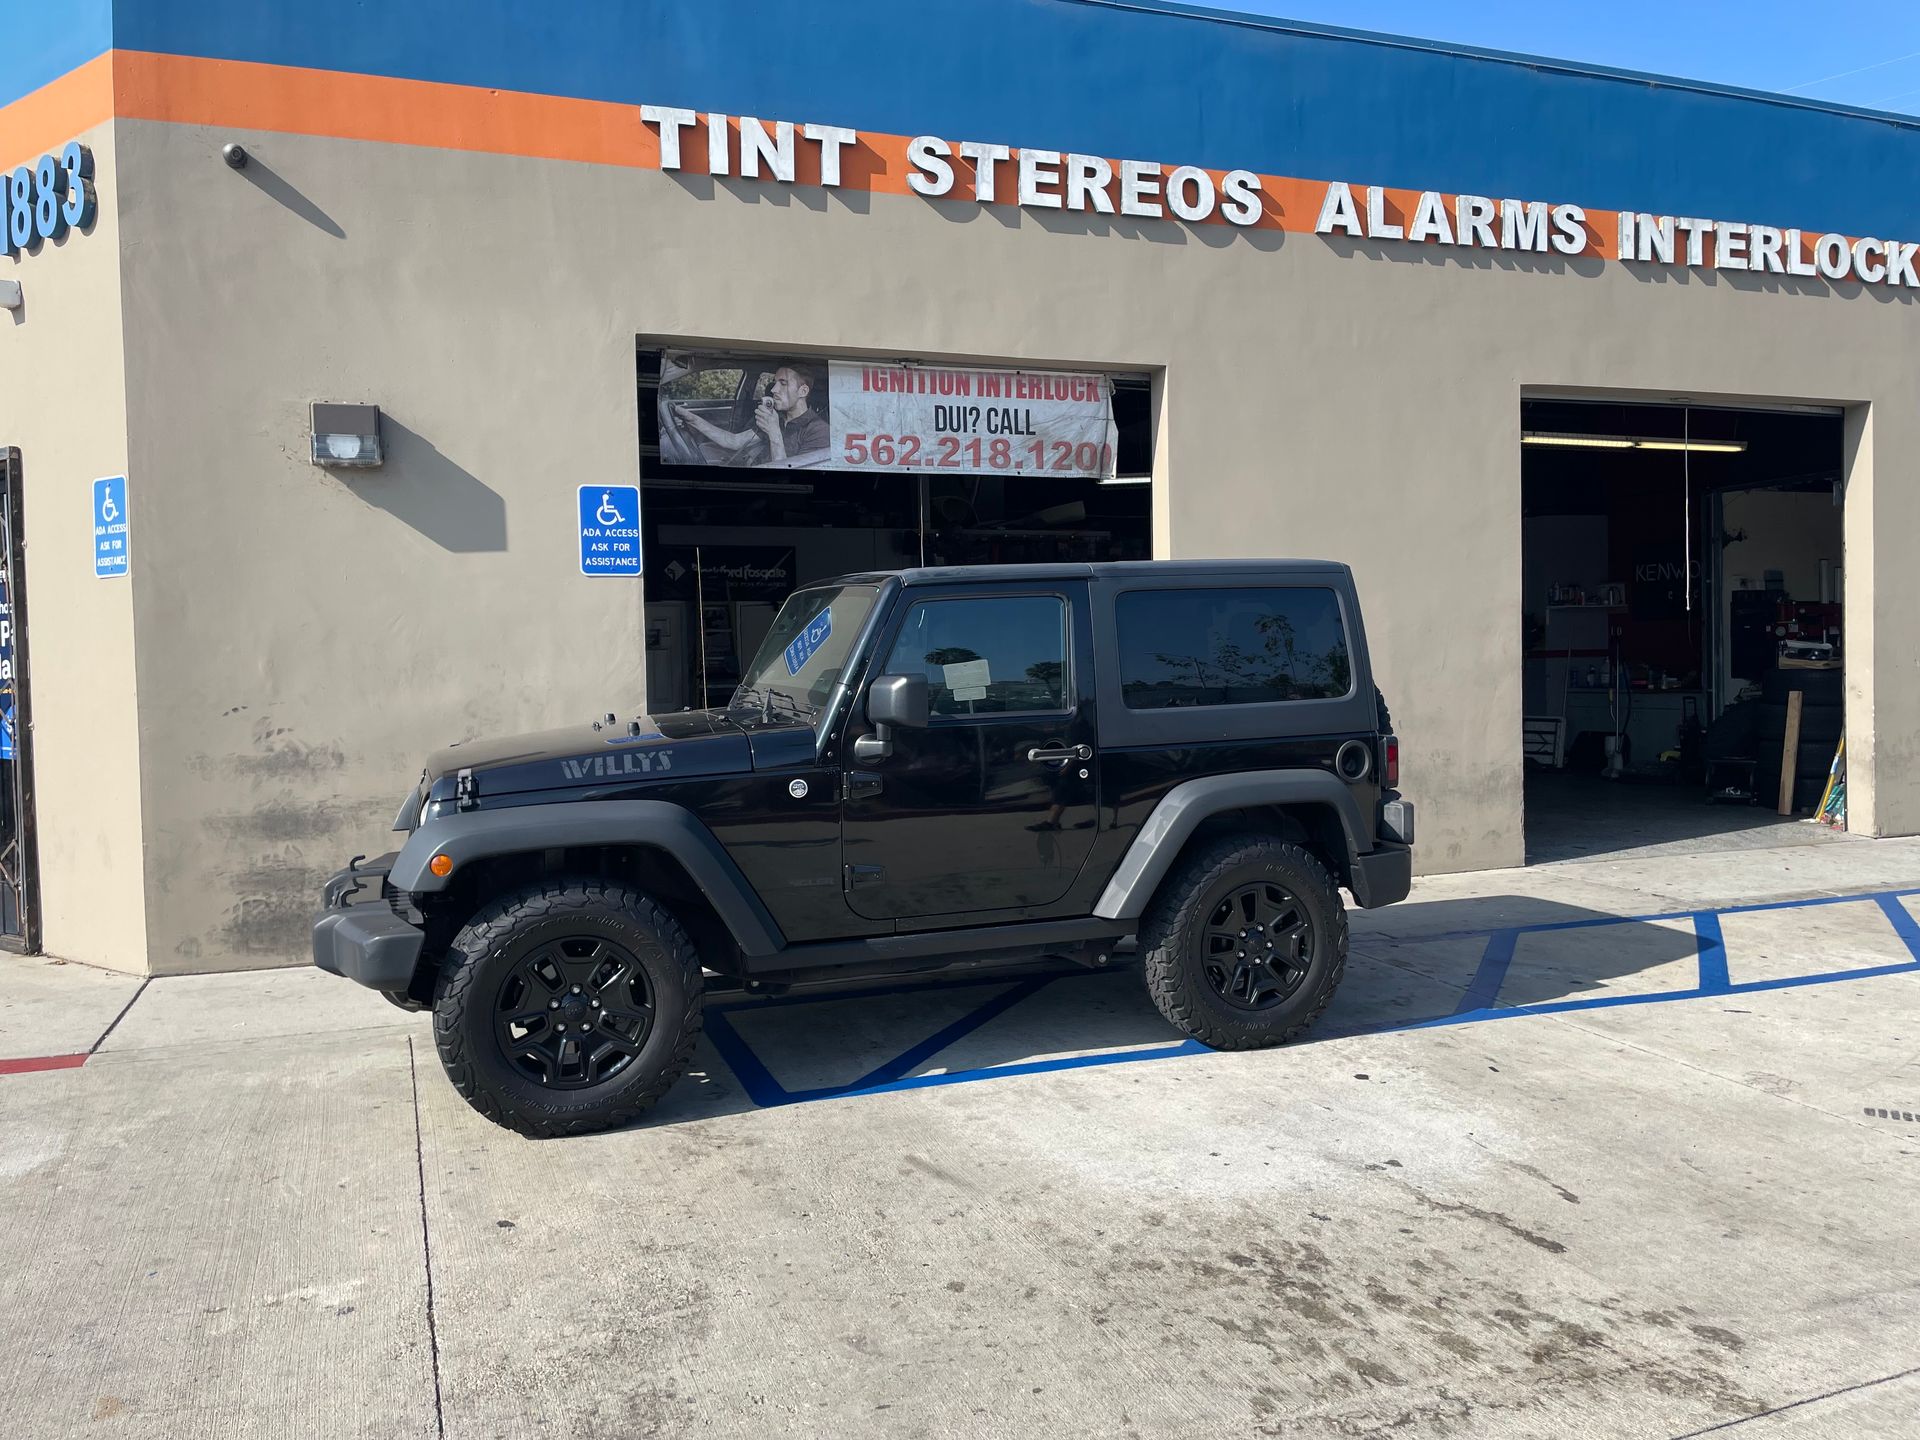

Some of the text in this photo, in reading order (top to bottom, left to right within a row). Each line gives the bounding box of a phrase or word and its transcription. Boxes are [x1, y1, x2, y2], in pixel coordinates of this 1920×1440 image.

[640, 104, 1920, 288] TINT STEREOS ALARMS INTERLOCK
[862, 367, 1100, 402] IGNITION INTERLOCK
[934, 405, 1036, 436] DUI? CALL
[95, 523, 127, 536] ADA ACCESS
[582, 528, 638, 537] ADA ACCESS
[100, 540, 122, 551] ASK FOR
[591, 543, 630, 551] ASK FOR
[97, 555, 126, 567] ASSISTANCE
[585, 557, 638, 566] ASSISTANCE
[560, 750, 673, 779] WILLYS
